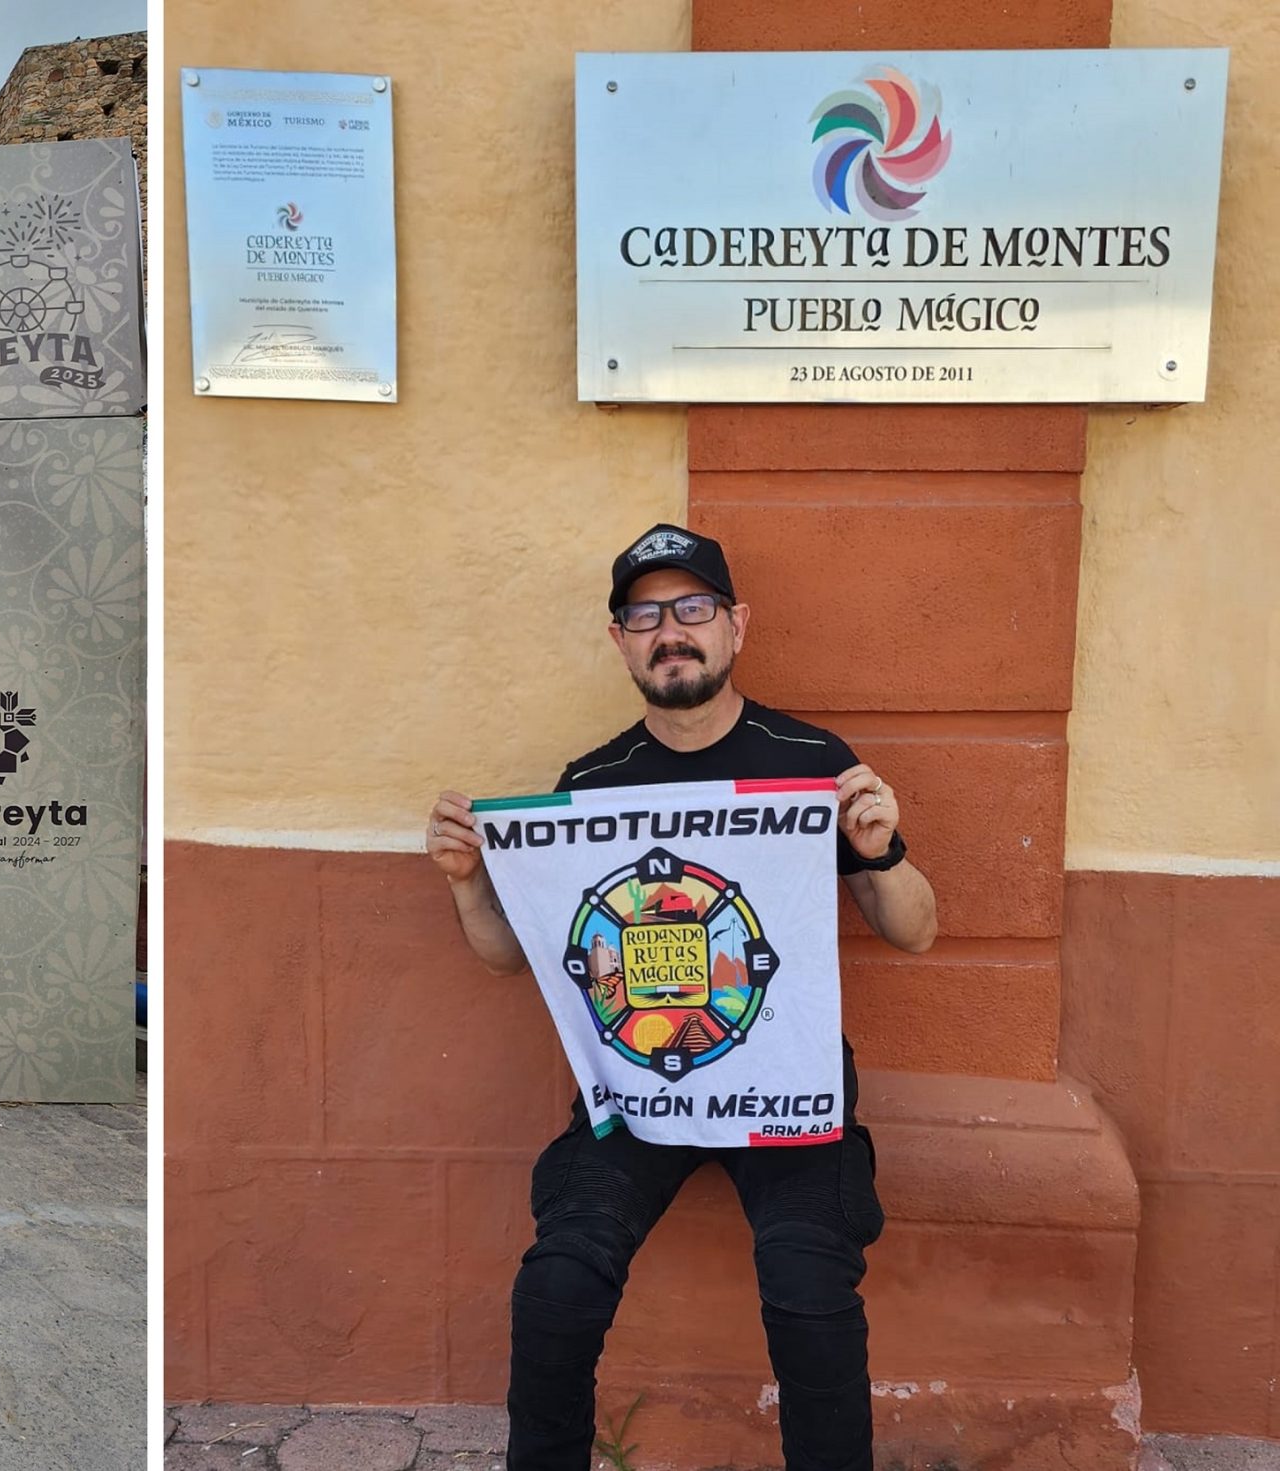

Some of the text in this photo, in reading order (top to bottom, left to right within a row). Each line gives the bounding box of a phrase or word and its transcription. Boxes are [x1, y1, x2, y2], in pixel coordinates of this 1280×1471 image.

[283, 116, 326, 126] TURISMO
[903, 227, 969, 267] DE
[49, 367, 98, 388] 2025
[790, 366, 974, 382] 23 DE AGOSTO DE 2011
[484, 805, 832, 850] MOTOTURISMO
[13, 837, 41, 847] 2024
[53, 837, 81, 847] 2027
[650, 859, 671, 875] N
[567, 960, 586, 975] O
[753, 953, 770, 971] E
[664, 1055, 682, 1071] S
[707, 1086, 835, 1119] MÉXICO
[762, 1122, 833, 1137] RRM 4.0
